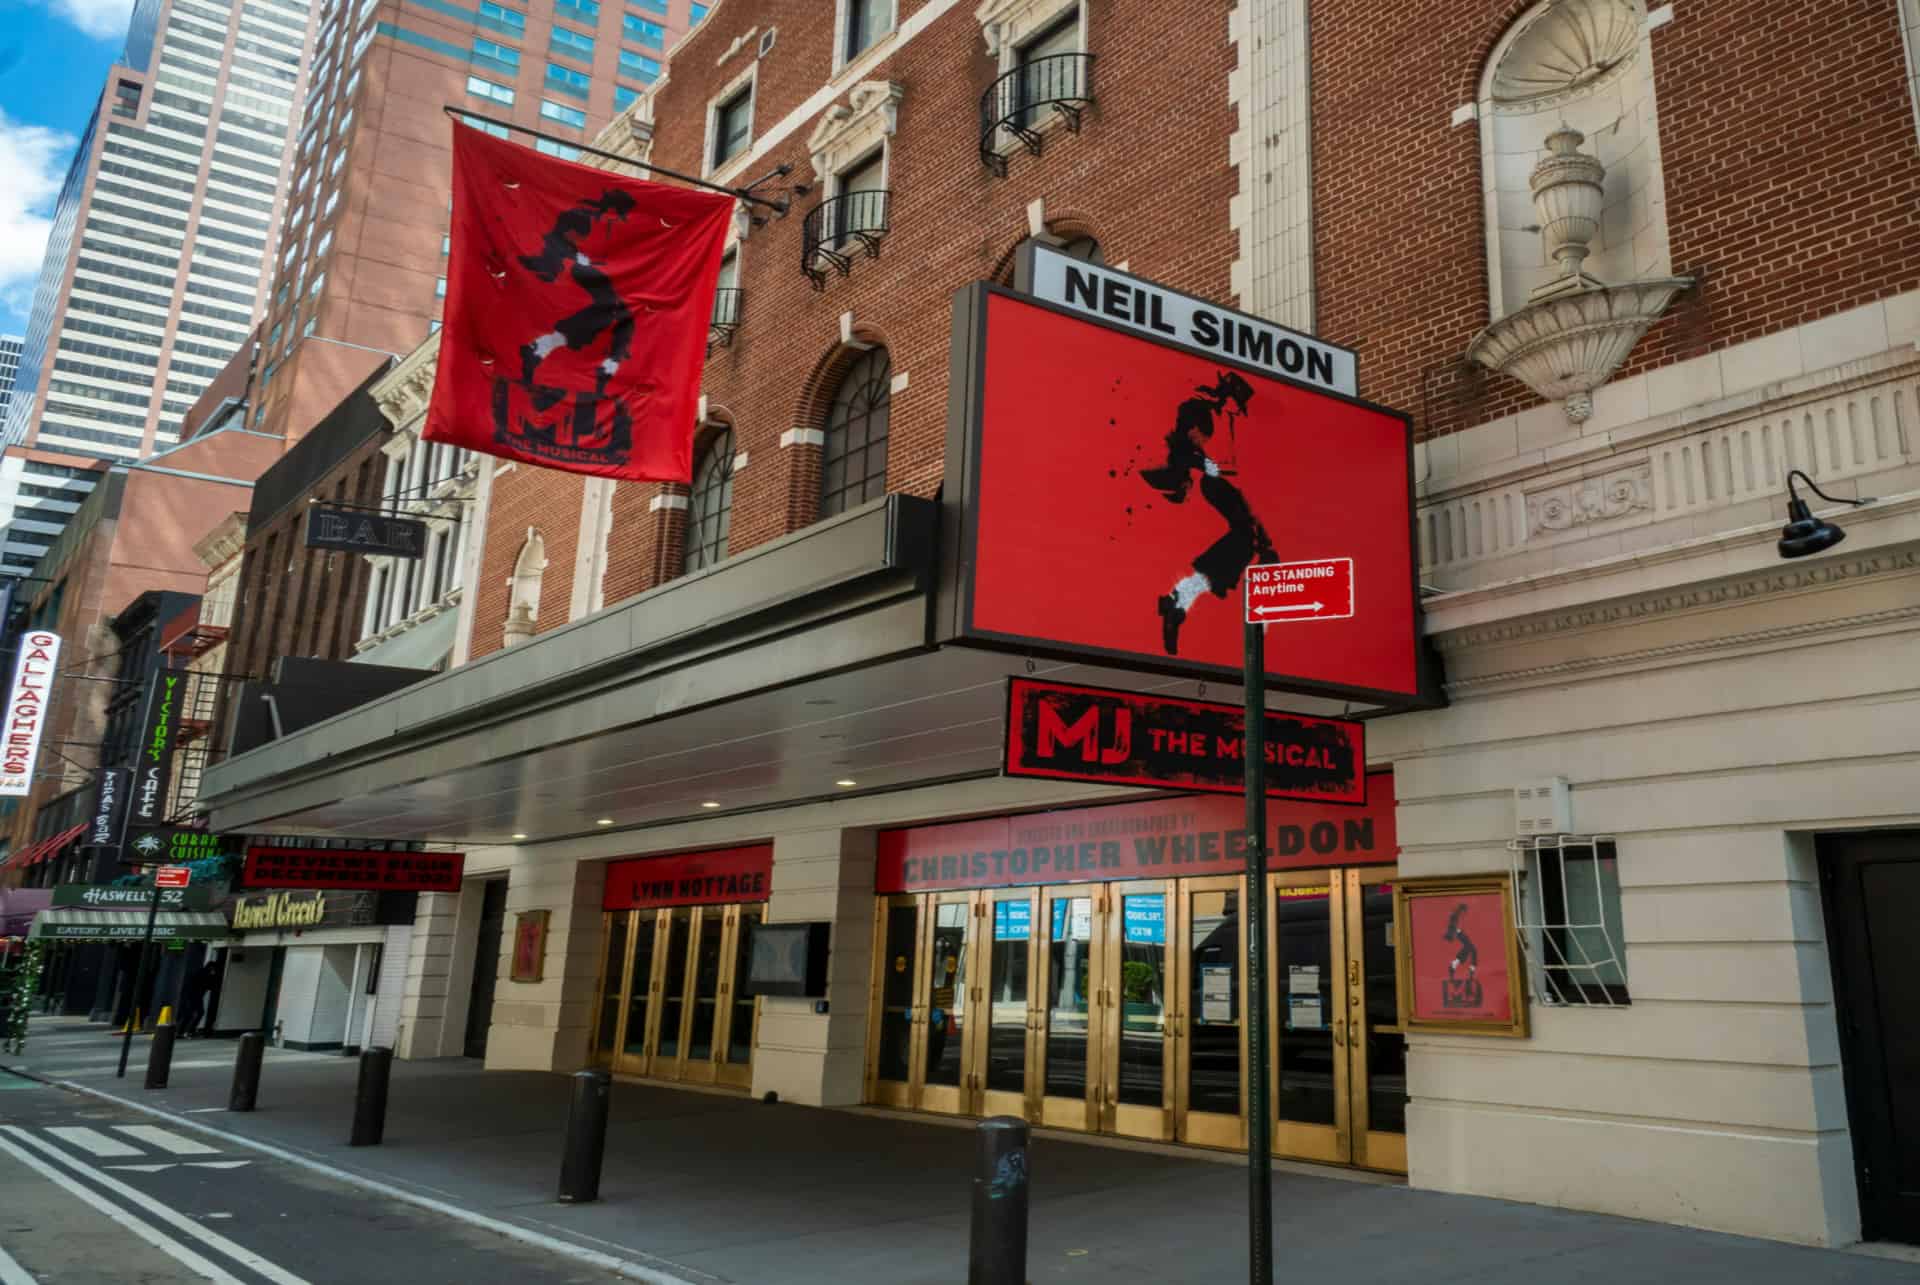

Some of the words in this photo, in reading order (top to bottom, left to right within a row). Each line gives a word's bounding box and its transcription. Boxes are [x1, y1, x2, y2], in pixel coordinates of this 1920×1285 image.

[1064, 264, 1176, 336] NEIL
[1190, 309, 1334, 385] SIMON
[507, 382, 617, 449] MJ
[536, 443, 609, 463] MUSICAL
[1252, 571, 1270, 583] NO
[1273, 566, 1335, 581] STANDING
[1253, 583, 1305, 597] Anytime
[2, 635, 53, 775] GALLAGHERS
[1036, 699, 1133, 764] MJ
[1149, 729, 1207, 757] THE
[903, 841, 1122, 884] CHRISTOPHER
[1134, 817, 1374, 868] WHEEDON
[159, 890, 184, 903] 52
